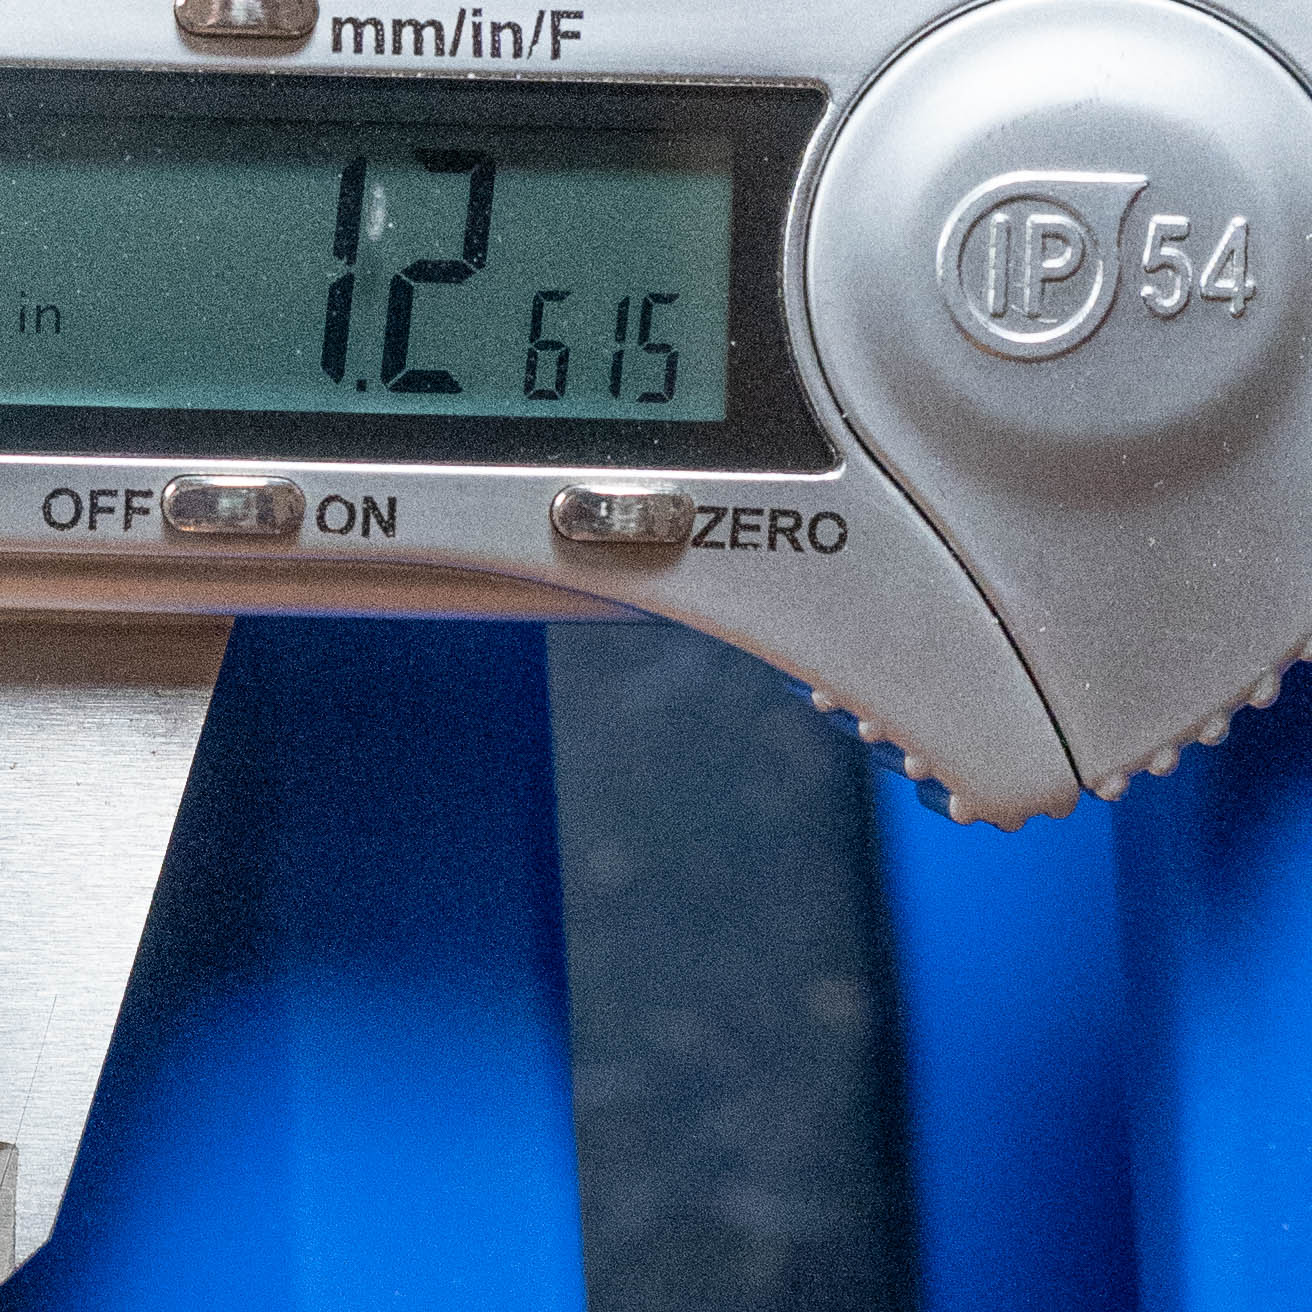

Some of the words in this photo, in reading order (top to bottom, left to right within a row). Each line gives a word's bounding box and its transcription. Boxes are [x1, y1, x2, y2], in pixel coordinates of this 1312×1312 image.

[331, 7, 585, 61] mm/in/F
[986, 212, 1089, 320] IP
[1138, 213, 1258, 320] 54
[18, 290, 62, 334] in
[41, 486, 153, 532] OFF
[315, 494, 399, 539] ON
[691, 504, 849, 555] ZERO
